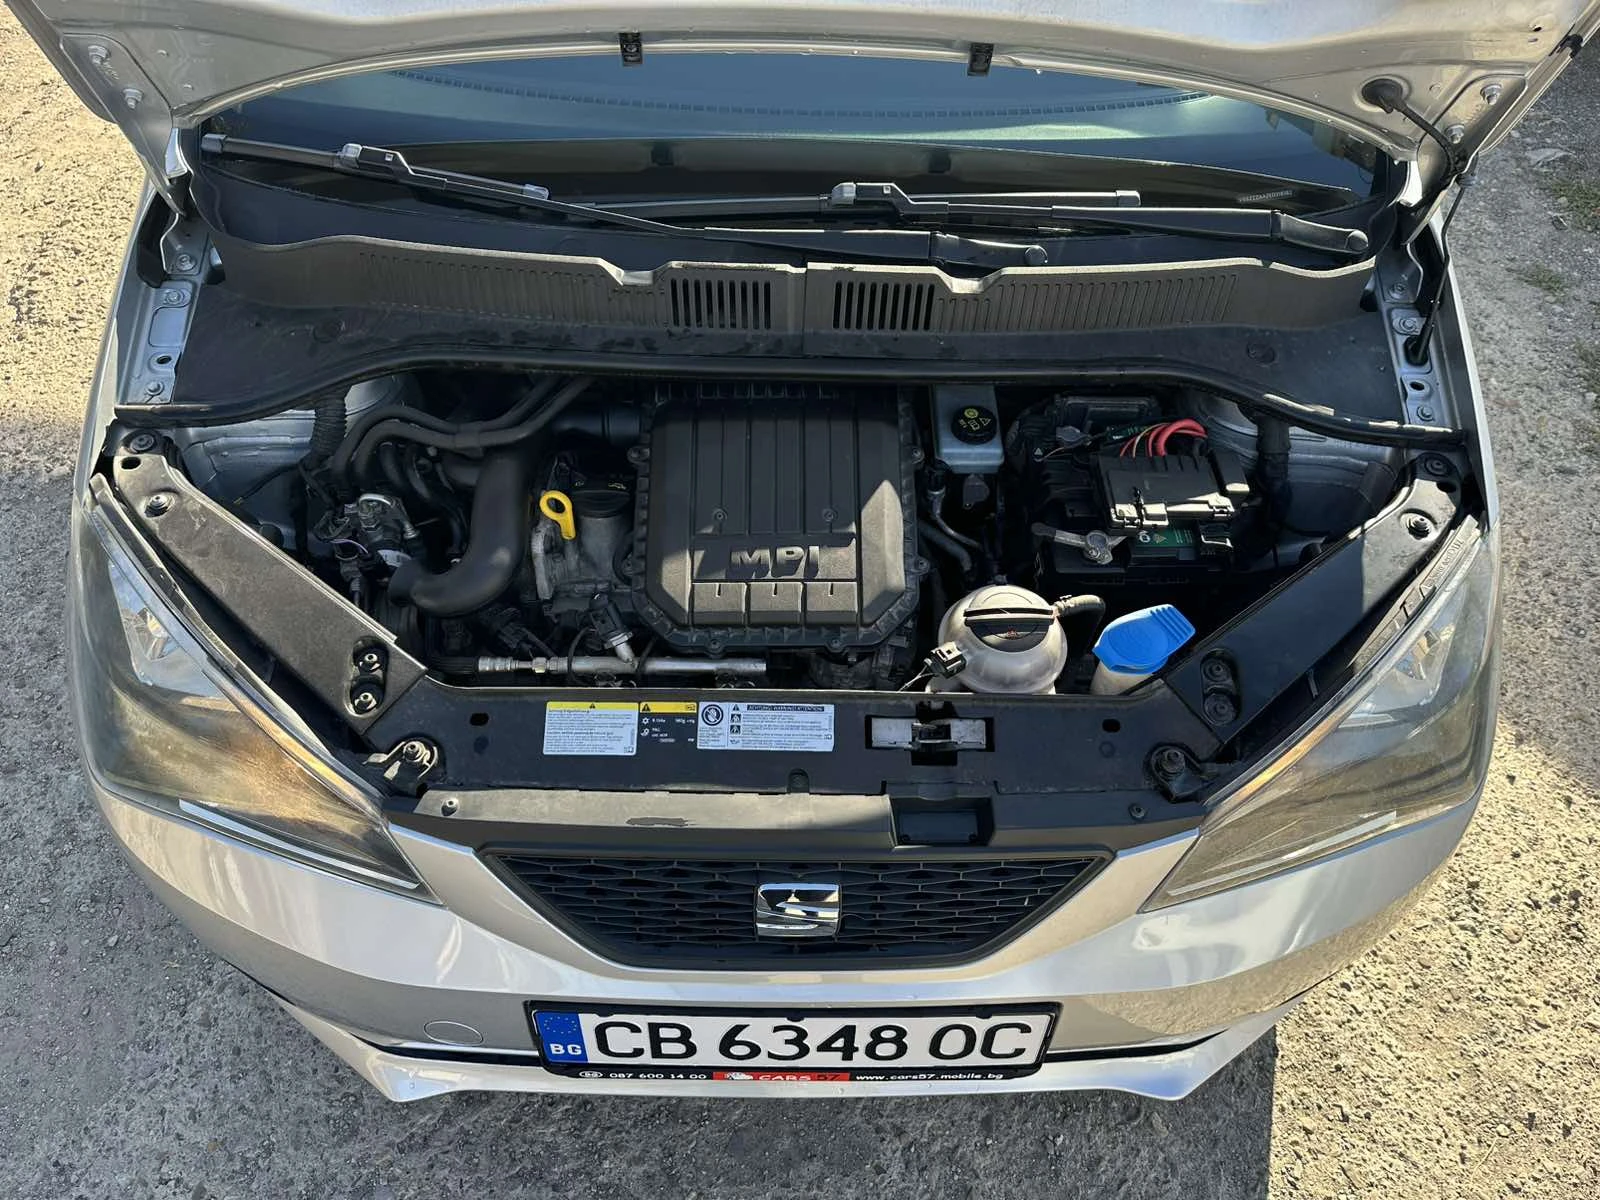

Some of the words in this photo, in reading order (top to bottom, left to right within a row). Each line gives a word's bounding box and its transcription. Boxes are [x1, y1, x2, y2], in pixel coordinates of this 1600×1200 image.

[731, 545, 820, 578] MPI
[549, 1043, 582, 1055] BG
[594, 1021, 697, 1059] CB
[718, 1023, 908, 1061] 6348
[928, 1022, 1033, 1060] OC
[856, 1073, 1004, 1081] www.cars57.mobile.bg
